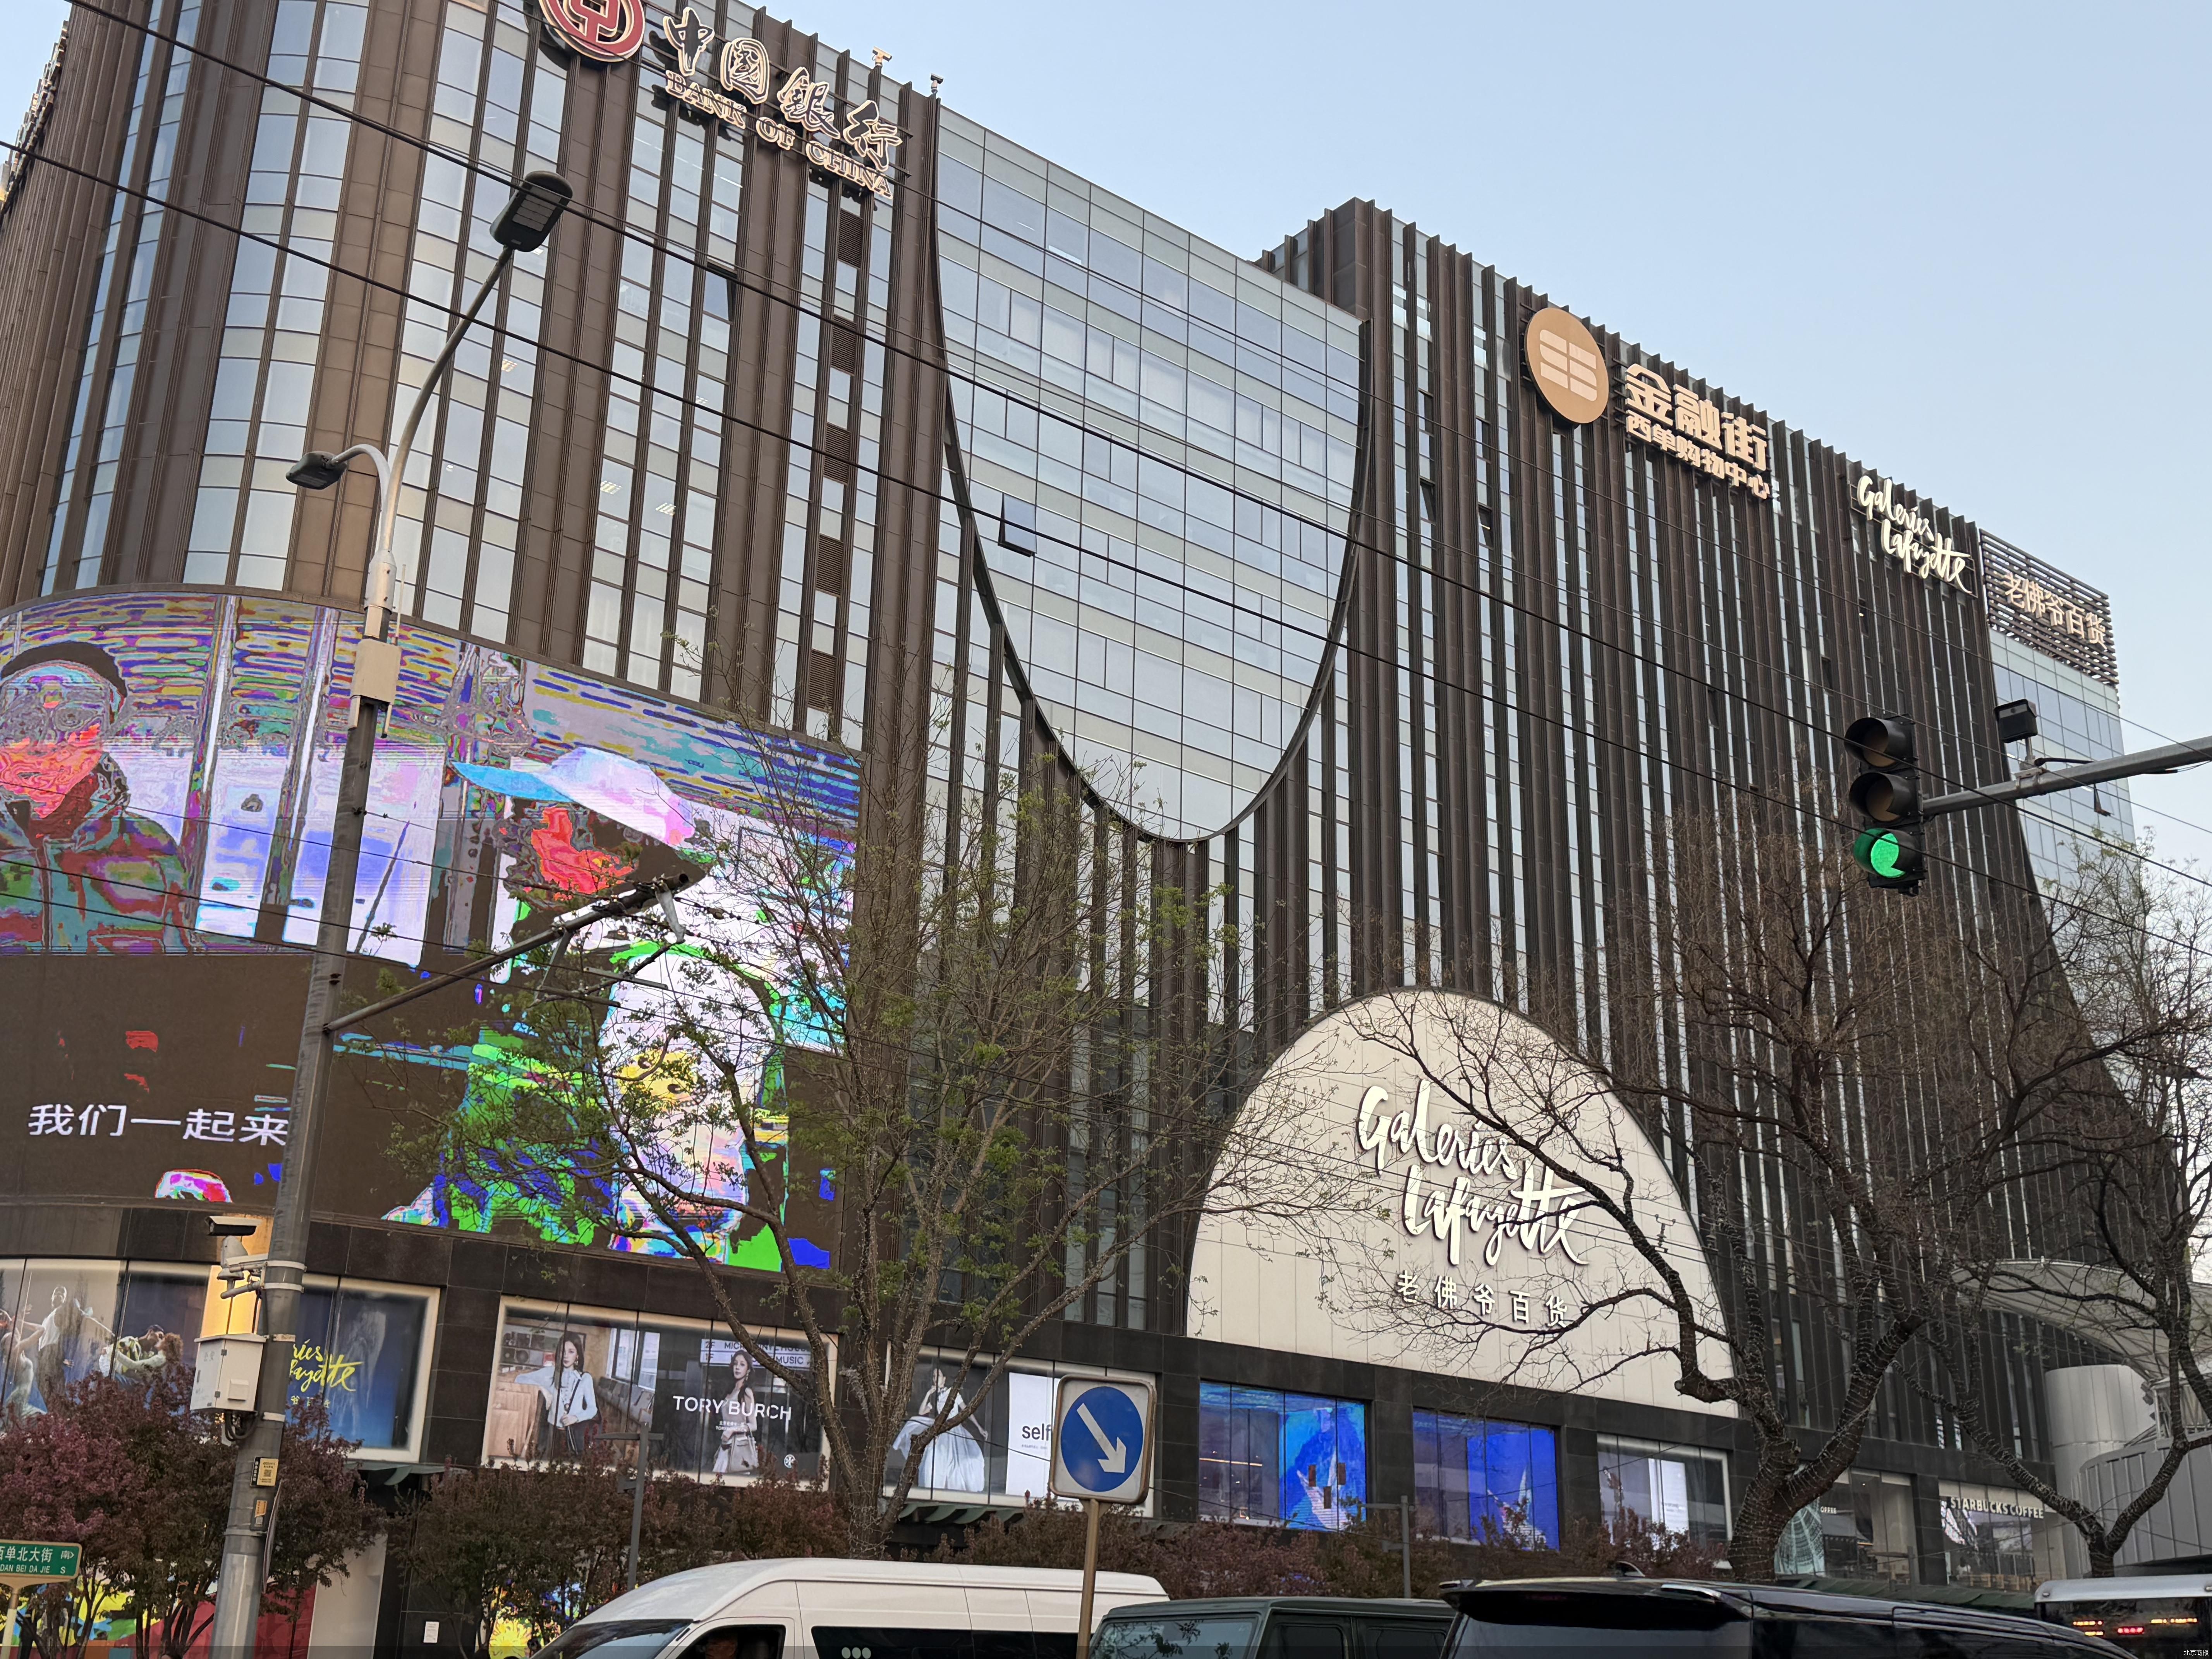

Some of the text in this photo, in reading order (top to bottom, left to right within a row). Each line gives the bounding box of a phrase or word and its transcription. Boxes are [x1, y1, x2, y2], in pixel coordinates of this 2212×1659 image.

[665, 70, 893, 199] BANK OF CHINA
[1625, 363, 1767, 471] 金融街
[1626, 409, 1770, 500] 西单购物中心
[1857, 475, 1934, 541] Galeries
[1881, 519, 1972, 593] Lafayette
[2002, 572, 2107, 650] 老佛爷百货
[28, 1104, 289, 1146] 我们一起来
[1358, 1079, 1518, 1180] Galeries
[1402, 1160, 1590, 1266] Lafayette
[1397, 1270, 1569, 1328] 老佛爷百货
[293, 1339, 323, 1362] ries
[776, 1356, 804, 1364] MUSIC
[673, 1396, 792, 1420] TORY BURCH
[1950, 1497, 2044, 1519] STARBUCKS COFFEE
[16, 1564, 26, 1572] BEI
[29, 1565, 38, 1573] DA
[60, 1566, 66, 1574] S
[61, 1551, 70, 1560] 南
